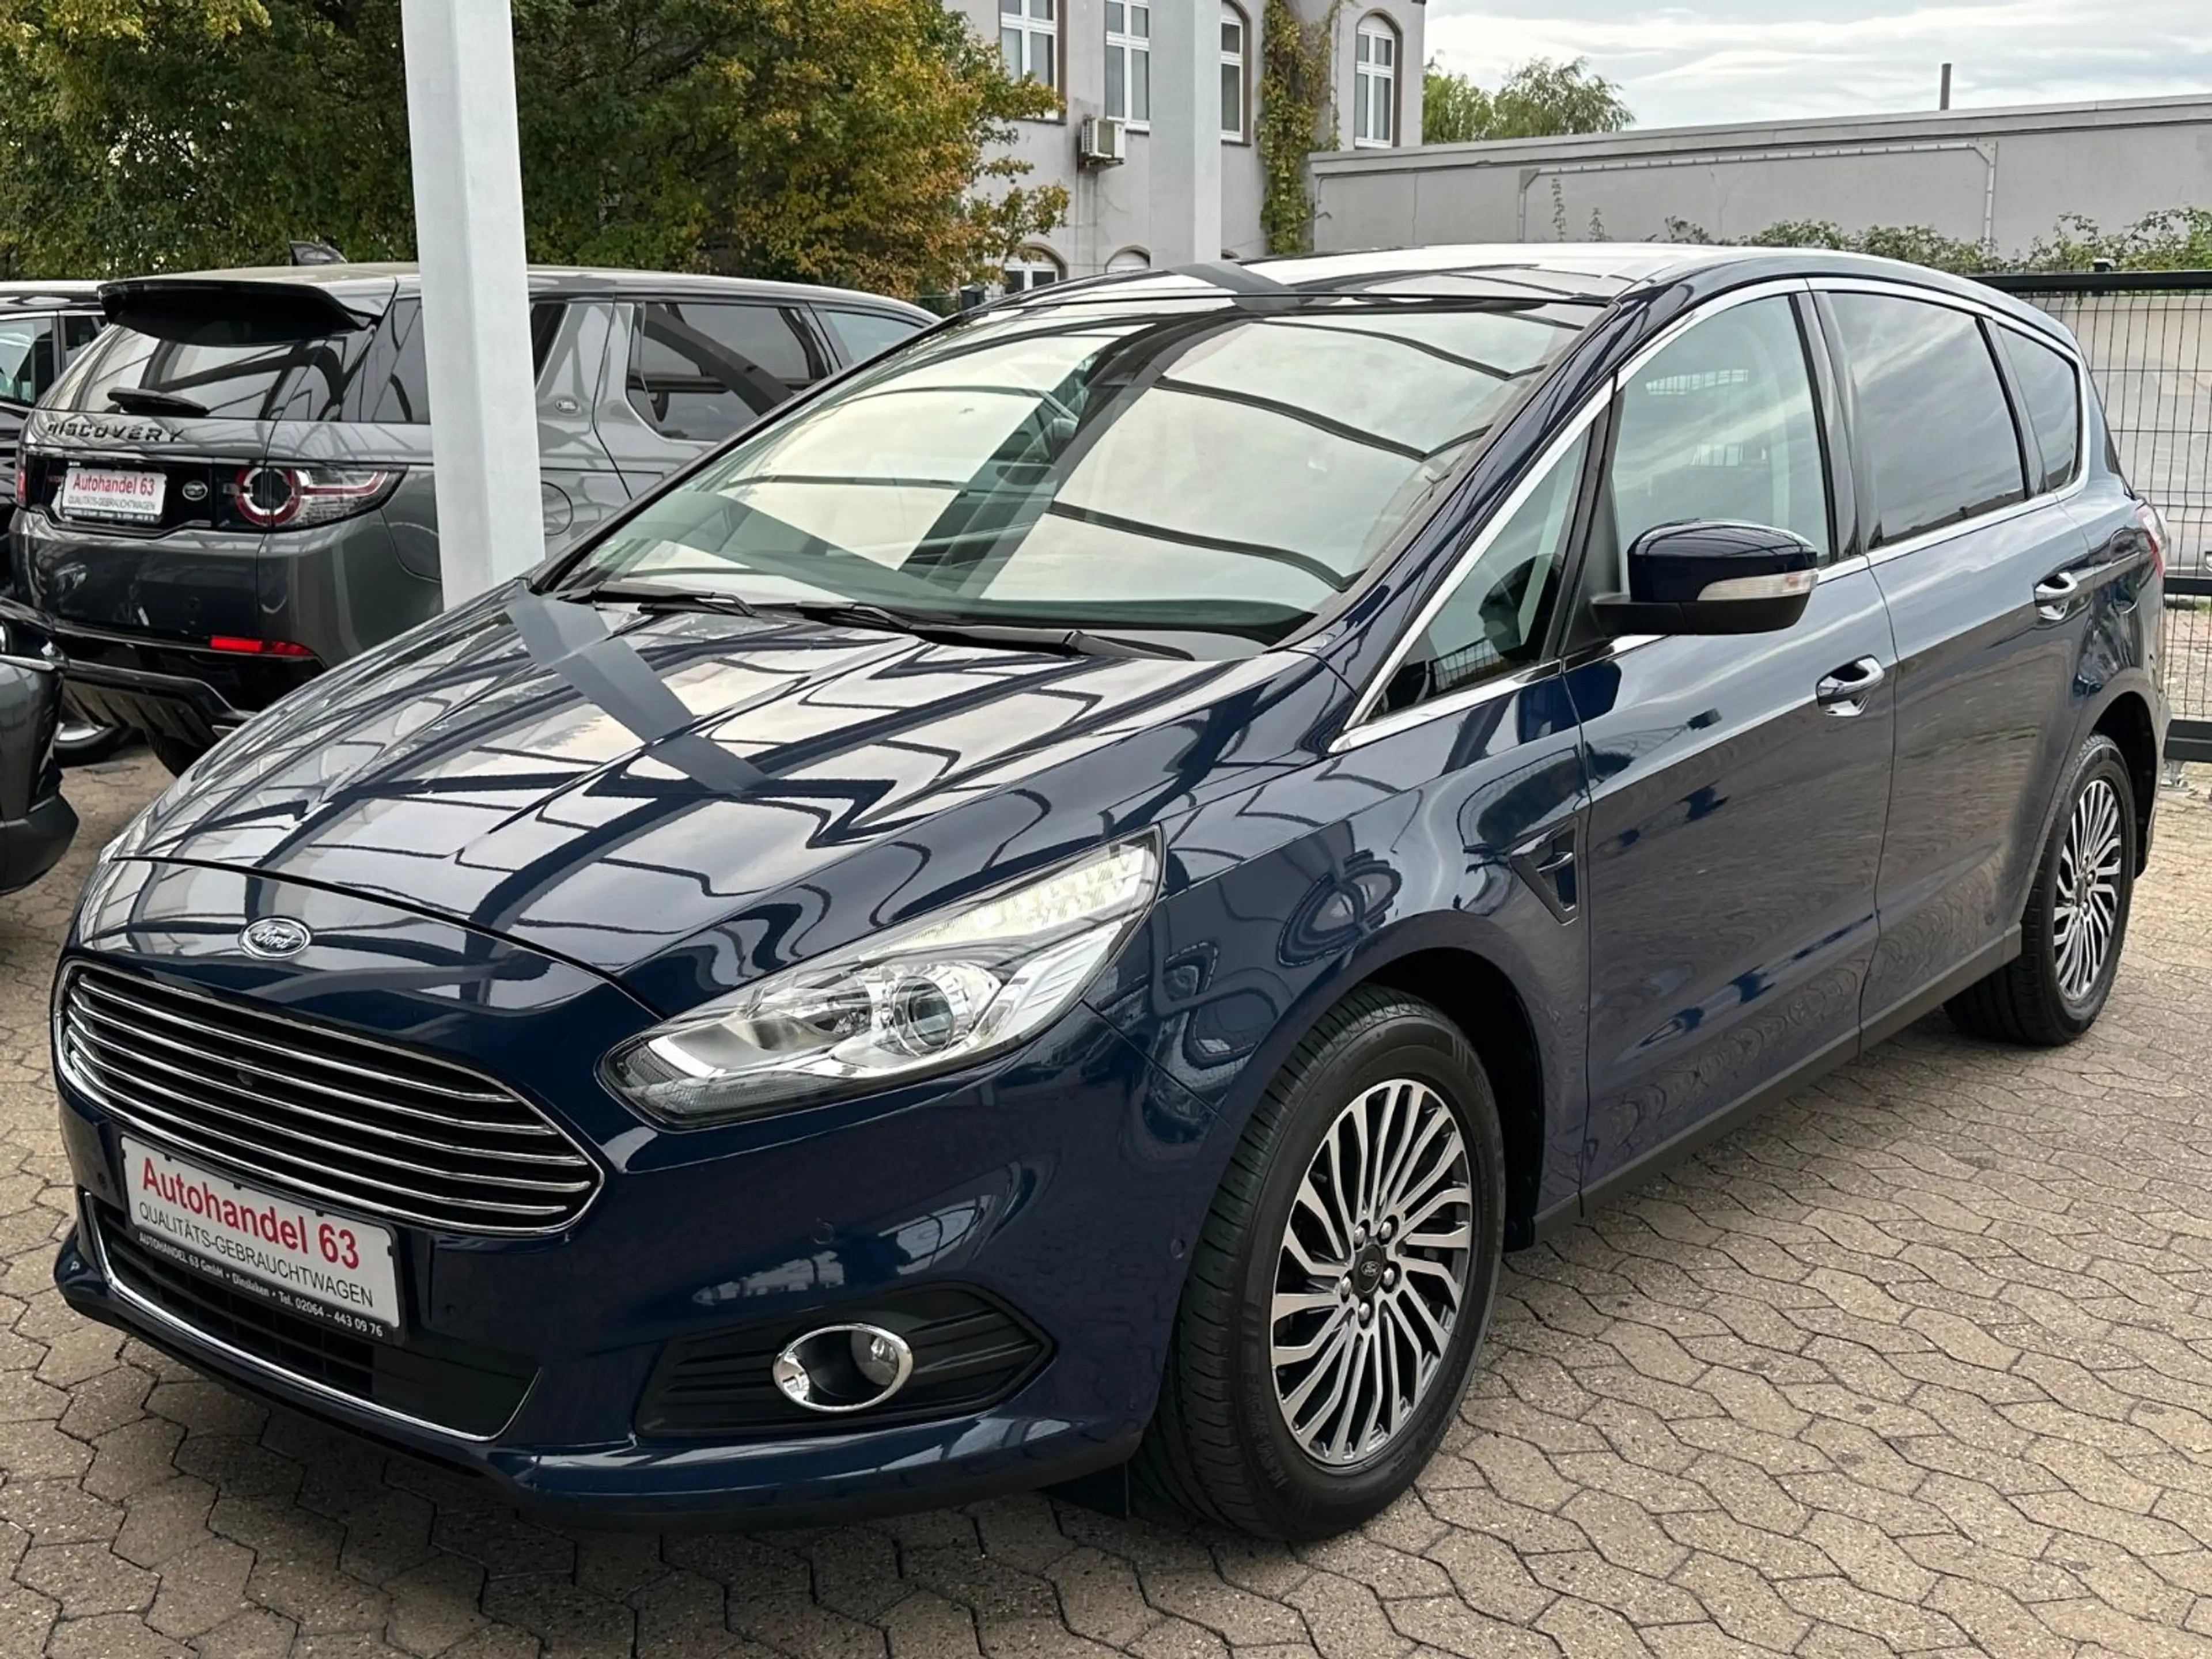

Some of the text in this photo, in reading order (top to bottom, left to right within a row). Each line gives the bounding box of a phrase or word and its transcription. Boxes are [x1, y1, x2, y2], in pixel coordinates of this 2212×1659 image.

[48, 422, 184, 442] DISCOVERY
[73, 473, 155, 497] Autohandel 63
[139, 1202, 373, 1308] QUALITÄTS-GEBRAUCHTWAGEN
[143, 1157, 359, 1270] Autohandel 63
[188, 1254, 199, 1268] 63
[295, 1298, 324, 1317] 02064
[334, 1311, 353, 1327] 443
[355, 1319, 368, 1332] 09
[370, 1325, 383, 1337] 76
